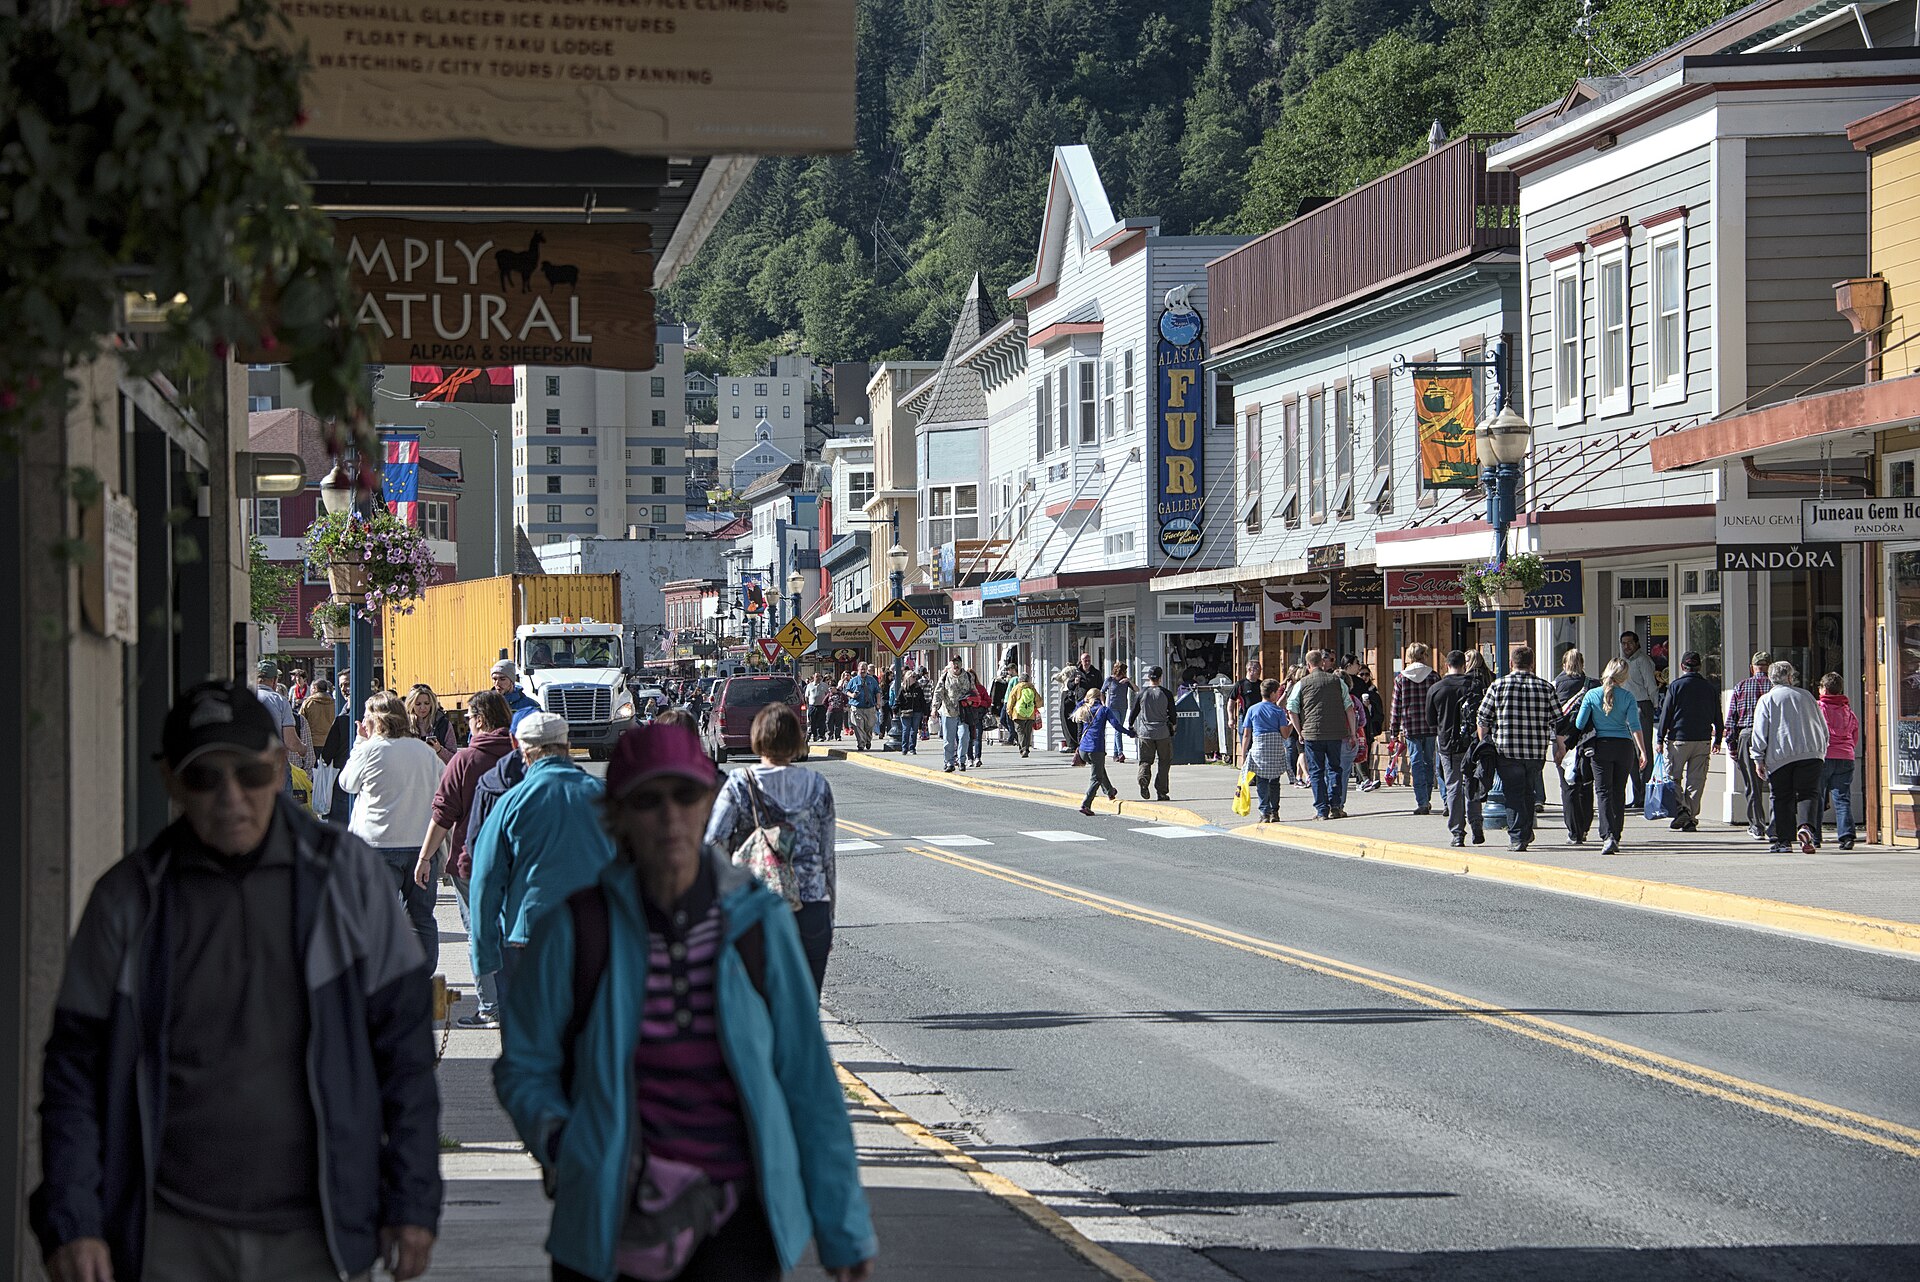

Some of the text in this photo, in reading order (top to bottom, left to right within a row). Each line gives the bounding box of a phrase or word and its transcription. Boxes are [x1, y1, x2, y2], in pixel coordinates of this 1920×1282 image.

[420, 9, 506, 27] GLACIER
[511, 12, 544, 28] ICE
[551, 15, 676, 33] ADVENTURES
[346, 30, 405, 47] FLOAT
[414, 33, 476, 50] PLANE
[495, 36, 545, 53] TAKU
[552, 39, 615, 56] LODGE
[319, 54, 422, 74] WATCHING
[438, 57, 483, 75] CITY
[489, 61, 553, 79] TOURS
[568, 64, 621, 81] GOLD
[626, 67, 713, 85] PANNING
[410, 344, 592, 362] ALPACA & SHEEPSKIN
[1159, 346, 1204, 366] ALASKA
[1165, 368, 1197, 493] FUR
[1158, 496, 1204, 515] GALLERY
[1812, 504, 1864, 525] Juneau
[1868, 503, 1899, 520] Gem
[1170, 519, 1192, 529] FUR
[1723, 515, 1765, 527] JUNEAU
[1769, 515, 1794, 525] GEM
[1854, 523, 1904, 534] PANDORA
[1724, 547, 1835, 569] PANDORA
[921, 607, 948, 616] ROYAL
[1056, 602, 1078, 617] Gallery
[1195, 603, 1255, 614] Diamond Island
[833, 628, 869, 637] Lambros
[978, 633, 998, 642] Jasmine
[998, 633, 1012, 641] Gems
